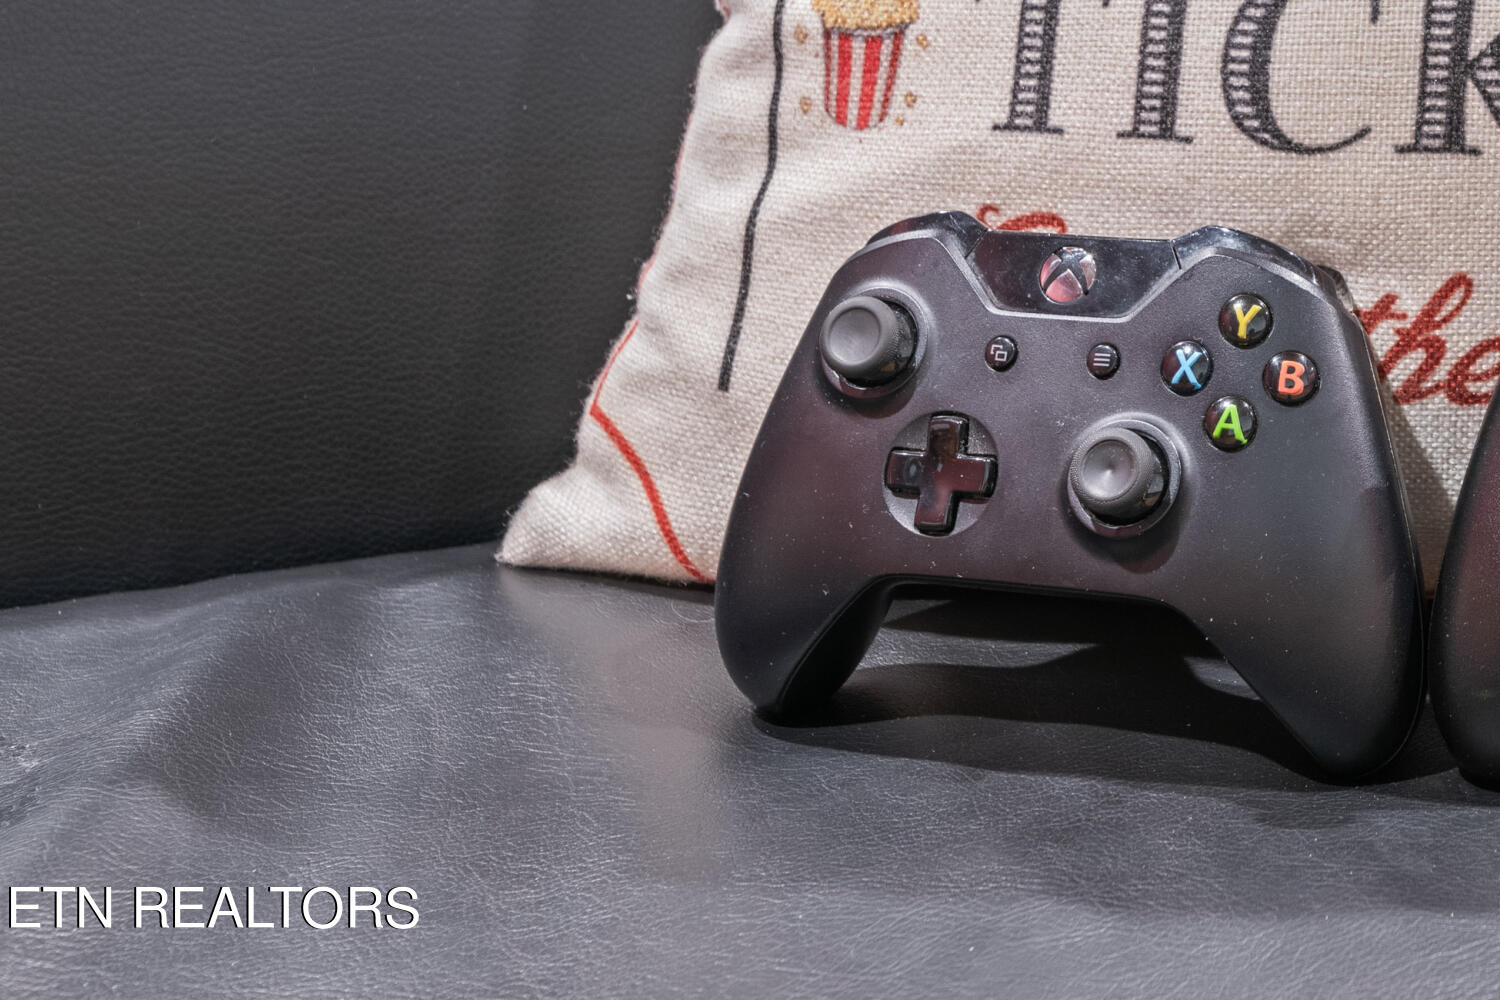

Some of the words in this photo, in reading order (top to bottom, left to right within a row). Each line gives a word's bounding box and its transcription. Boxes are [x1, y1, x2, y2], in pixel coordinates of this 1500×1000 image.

[1232, 303, 1262, 339] Y
[1171, 349, 1203, 390] X
[1277, 359, 1305, 395] B
[1213, 404, 1247, 444] A
